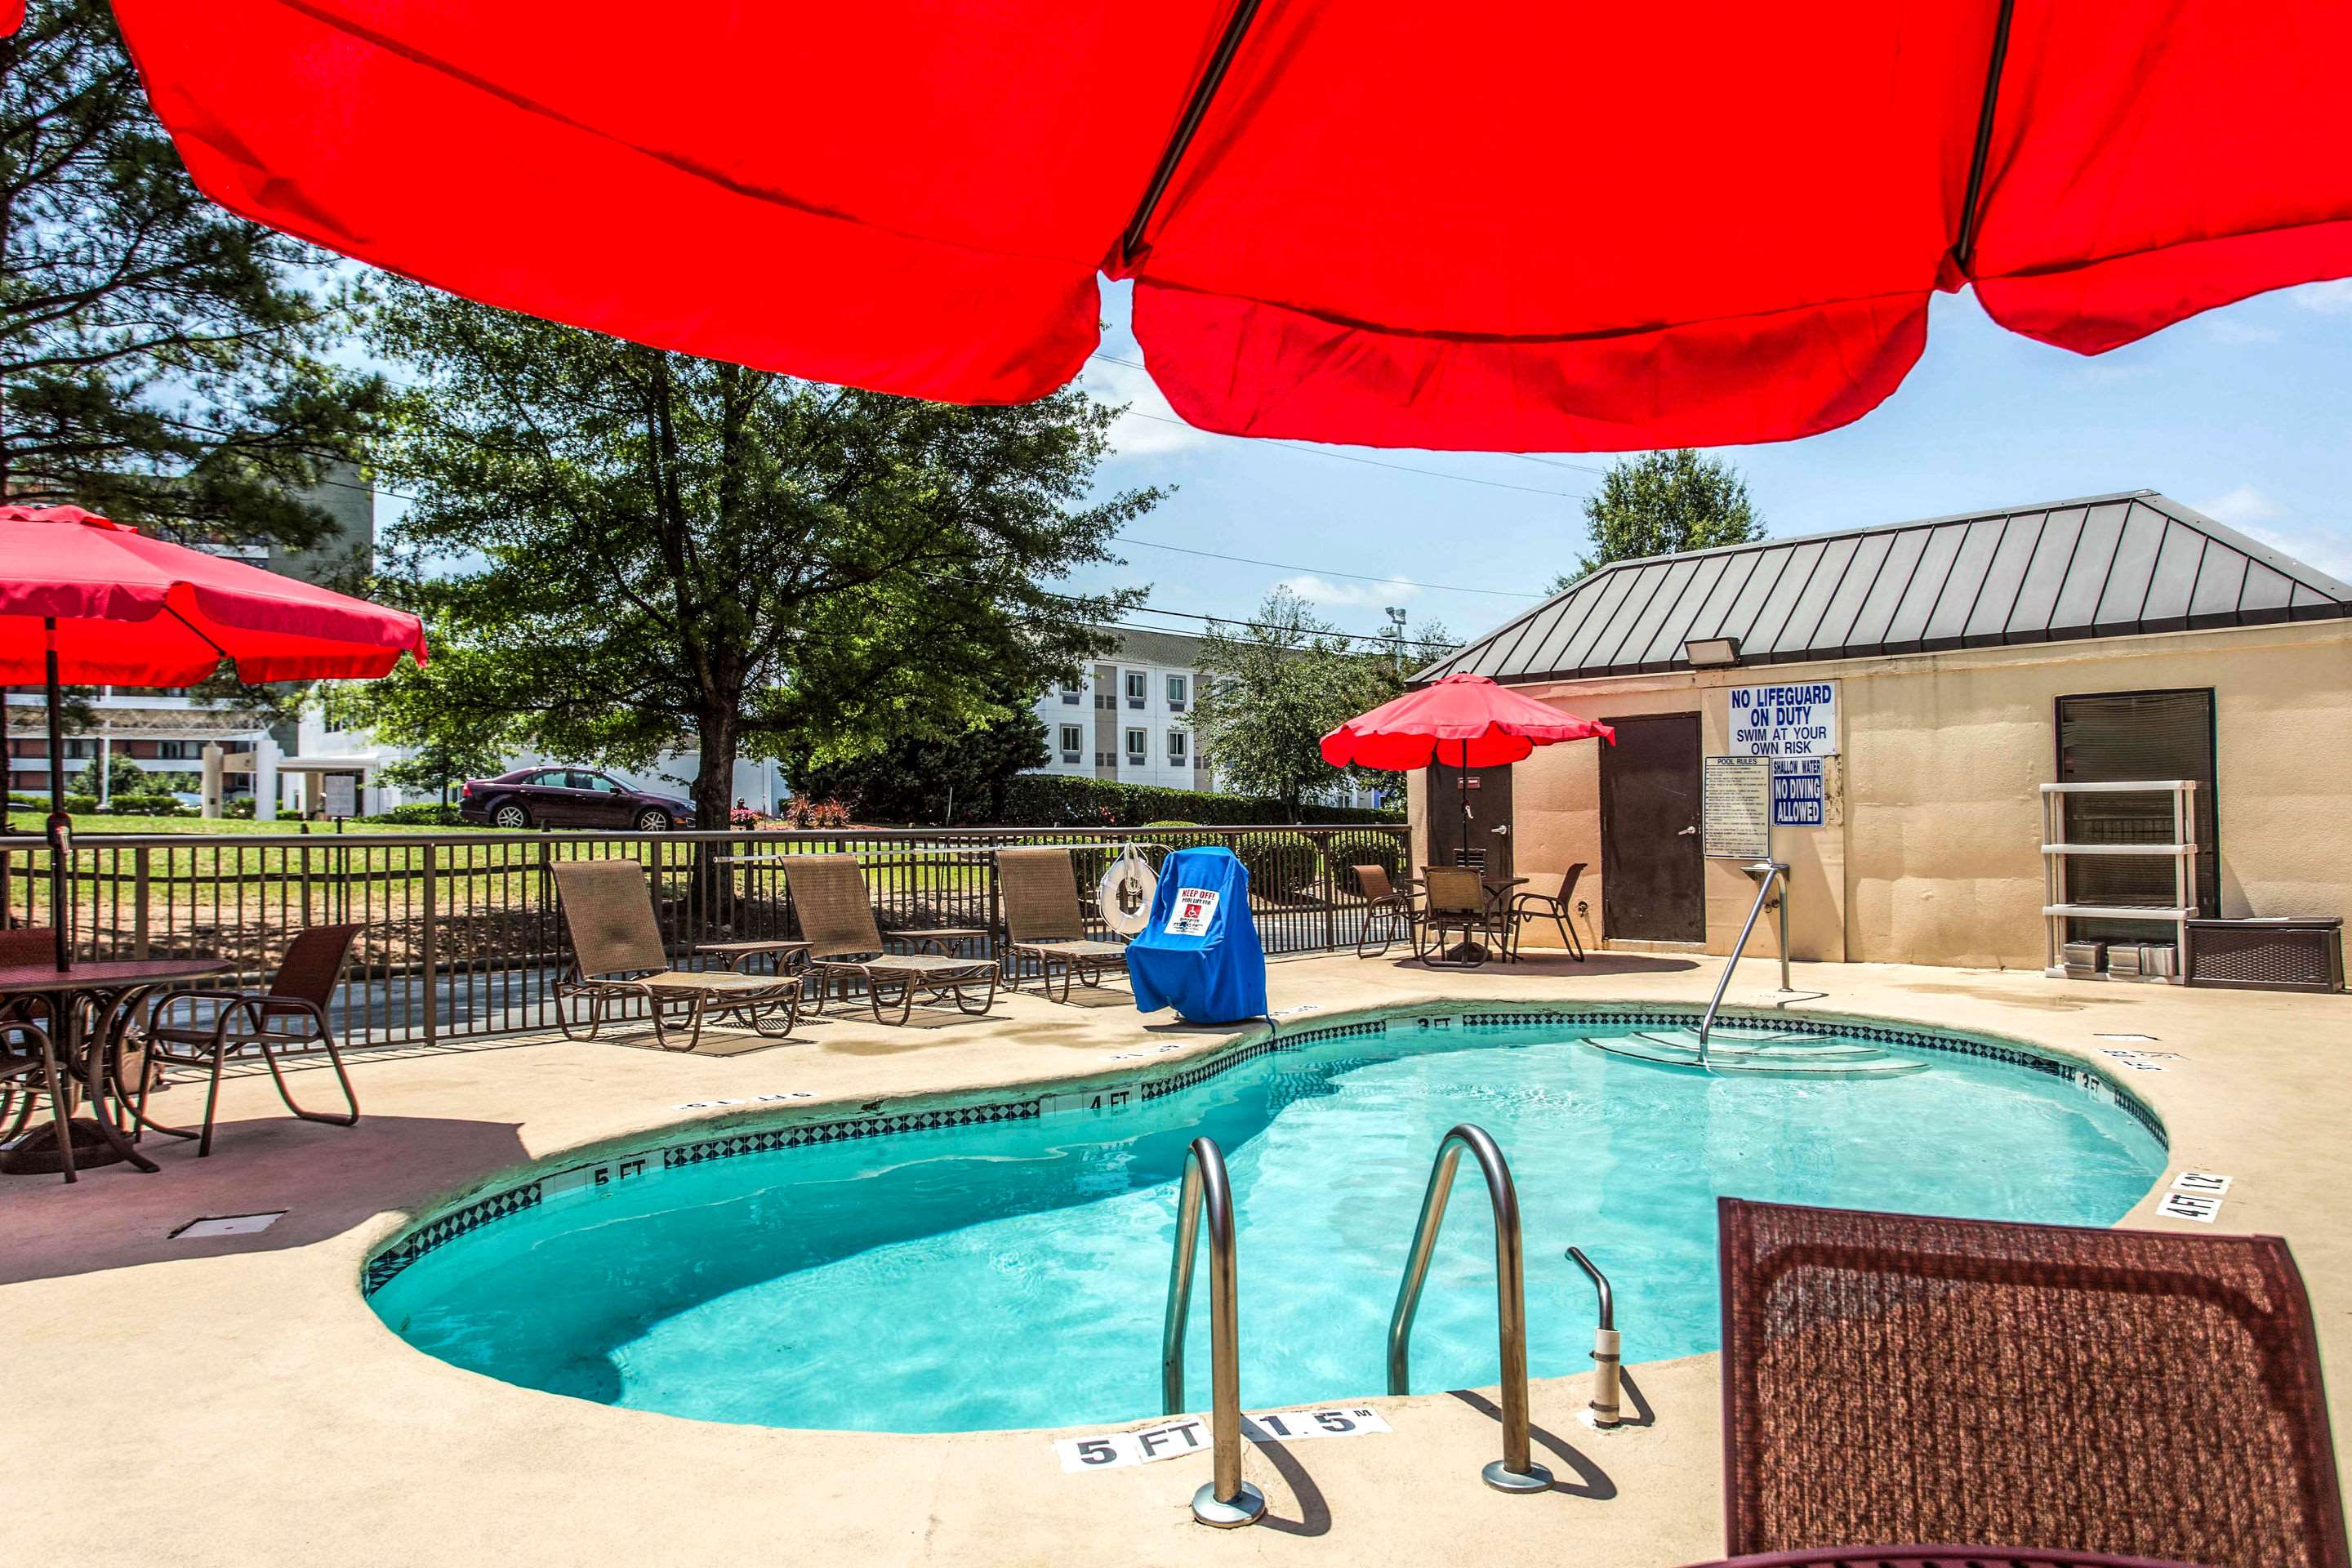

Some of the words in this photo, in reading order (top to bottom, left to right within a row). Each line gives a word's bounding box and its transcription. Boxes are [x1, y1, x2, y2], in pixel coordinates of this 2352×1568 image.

[1731, 689, 1750, 708] NO
[1757, 685, 1832, 706] LIFEGUARD
[1751, 708, 1769, 727] ON
[1776, 706, 1811, 726] DUTY
[1737, 728, 1766, 742] SWIM
[1772, 728, 1788, 740] AT
[1793, 726, 1827, 739] YOUR
[1751, 742, 1779, 755] OWN
[1784, 741, 1811, 754] RISK
[1774, 760, 1798, 774] SHALLOW
[1802, 760, 1820, 773] WATER
[1775, 778, 1788, 800] NO
[1789, 778, 1820, 799] DIVING
[1777, 801, 1819, 822] ALLOWED
[1182, 889, 1199, 898] KEEP
[1199, 891, 1215, 900] OFF!
[1110, 1091, 1129, 1107] FT
[595, 1167, 609, 1186] 5
[620, 1159, 646, 1180] FT
[1076, 1440, 1117, 1465] 5
[1138, 1423, 1200, 1457] FT
